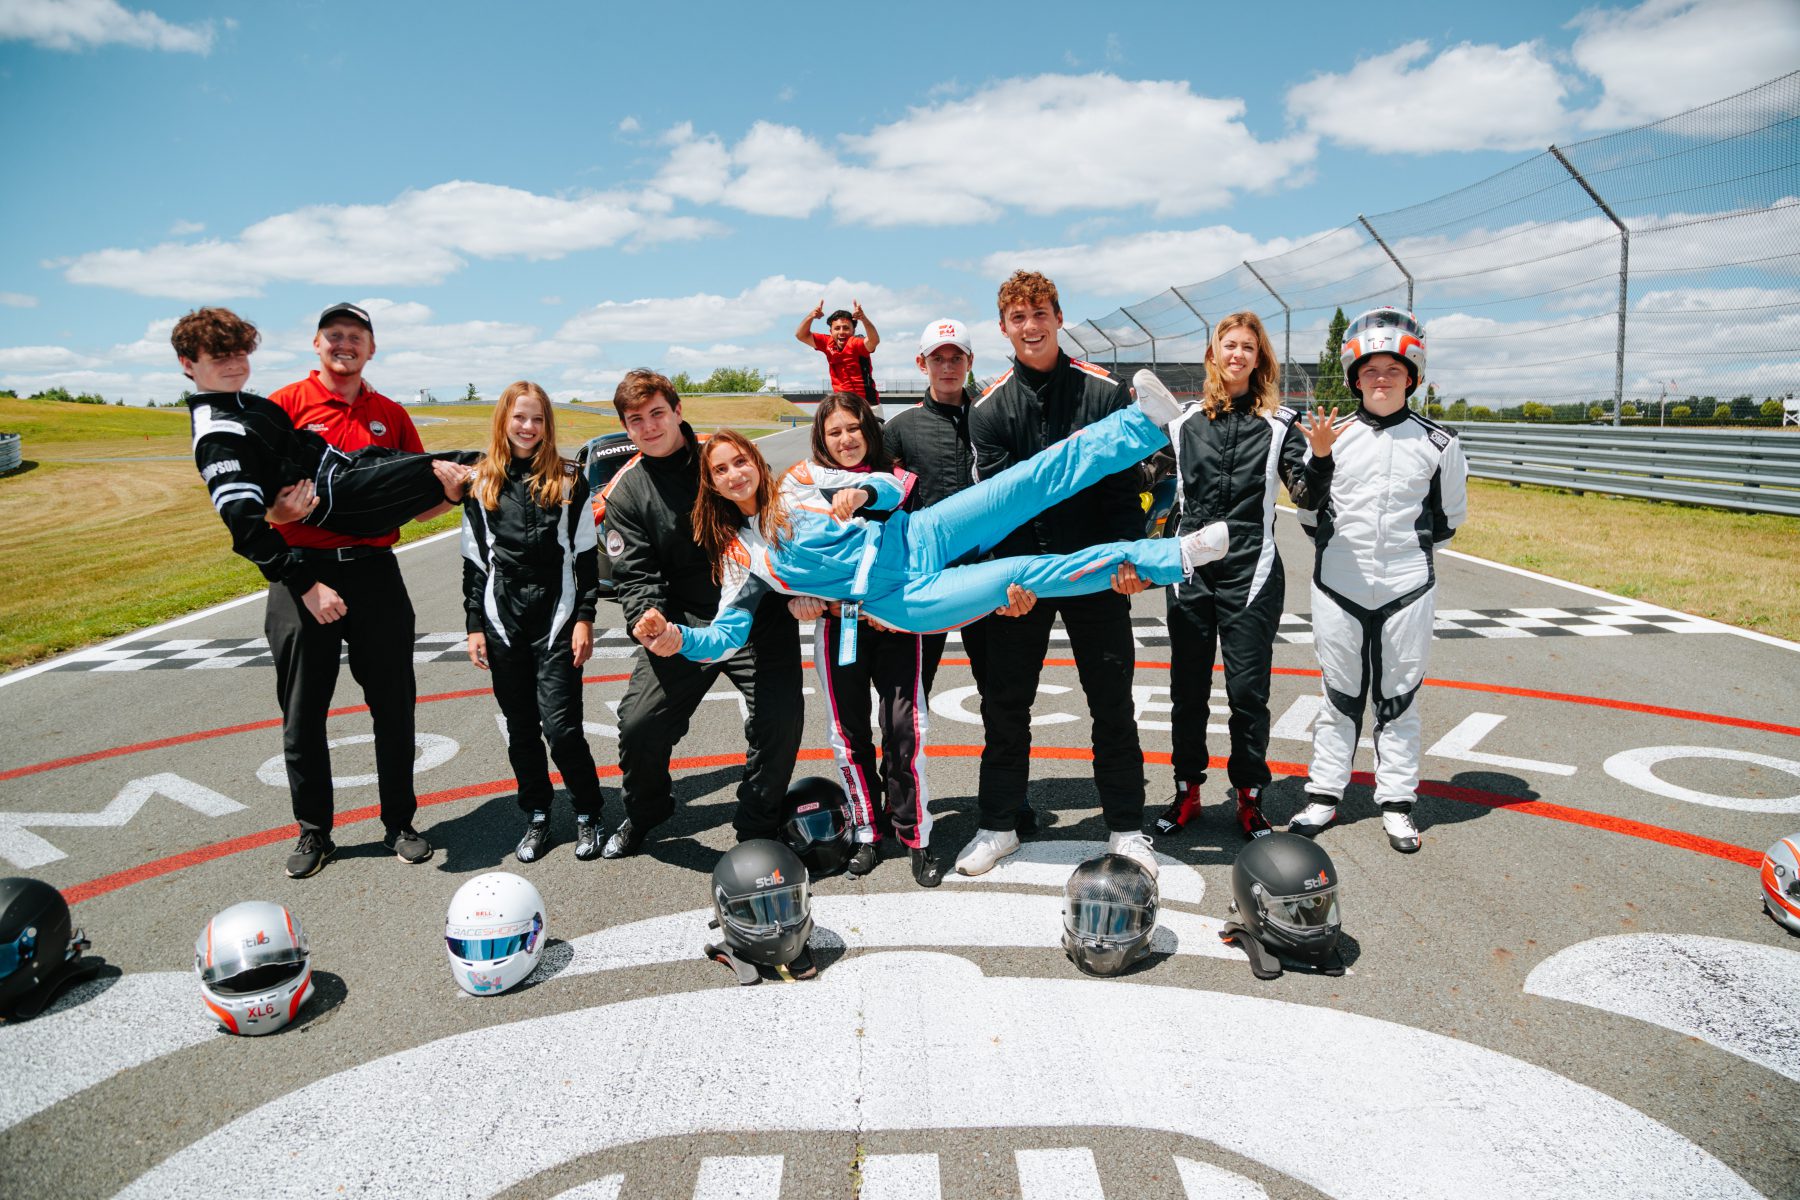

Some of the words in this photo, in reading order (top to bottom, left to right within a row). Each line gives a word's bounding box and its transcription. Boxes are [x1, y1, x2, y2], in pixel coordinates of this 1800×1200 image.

[1372, 341, 1385, 350] L7
[1431, 431, 1447, 445] OMP
[596, 444, 639, 458] MONTIC
[202, 460, 242, 484] MPSON
[247, 1003, 274, 1018] XL6
